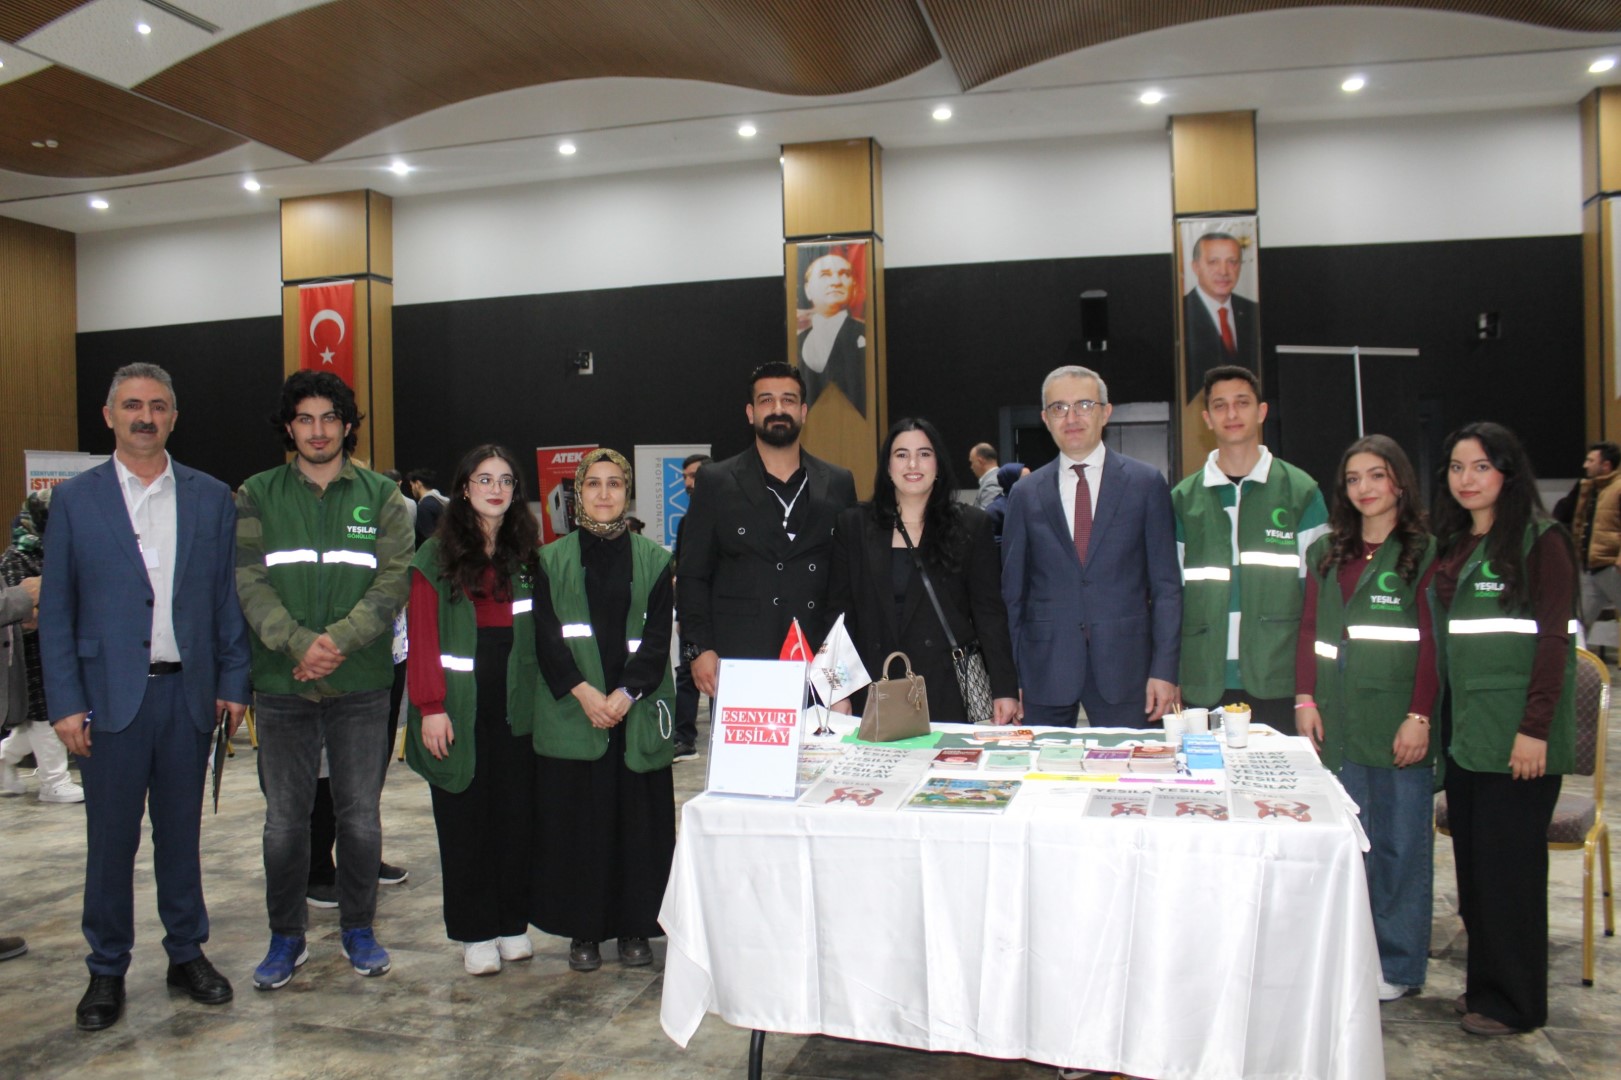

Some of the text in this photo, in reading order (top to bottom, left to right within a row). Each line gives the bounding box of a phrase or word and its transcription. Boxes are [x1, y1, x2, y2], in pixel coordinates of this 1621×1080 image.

[551, 452, 584, 464] ATEK
[655, 458, 663, 528] PROFESSIONAL
[722, 710, 797, 724] ESENYURT
[726, 727, 790, 744] YEŞİLAY
